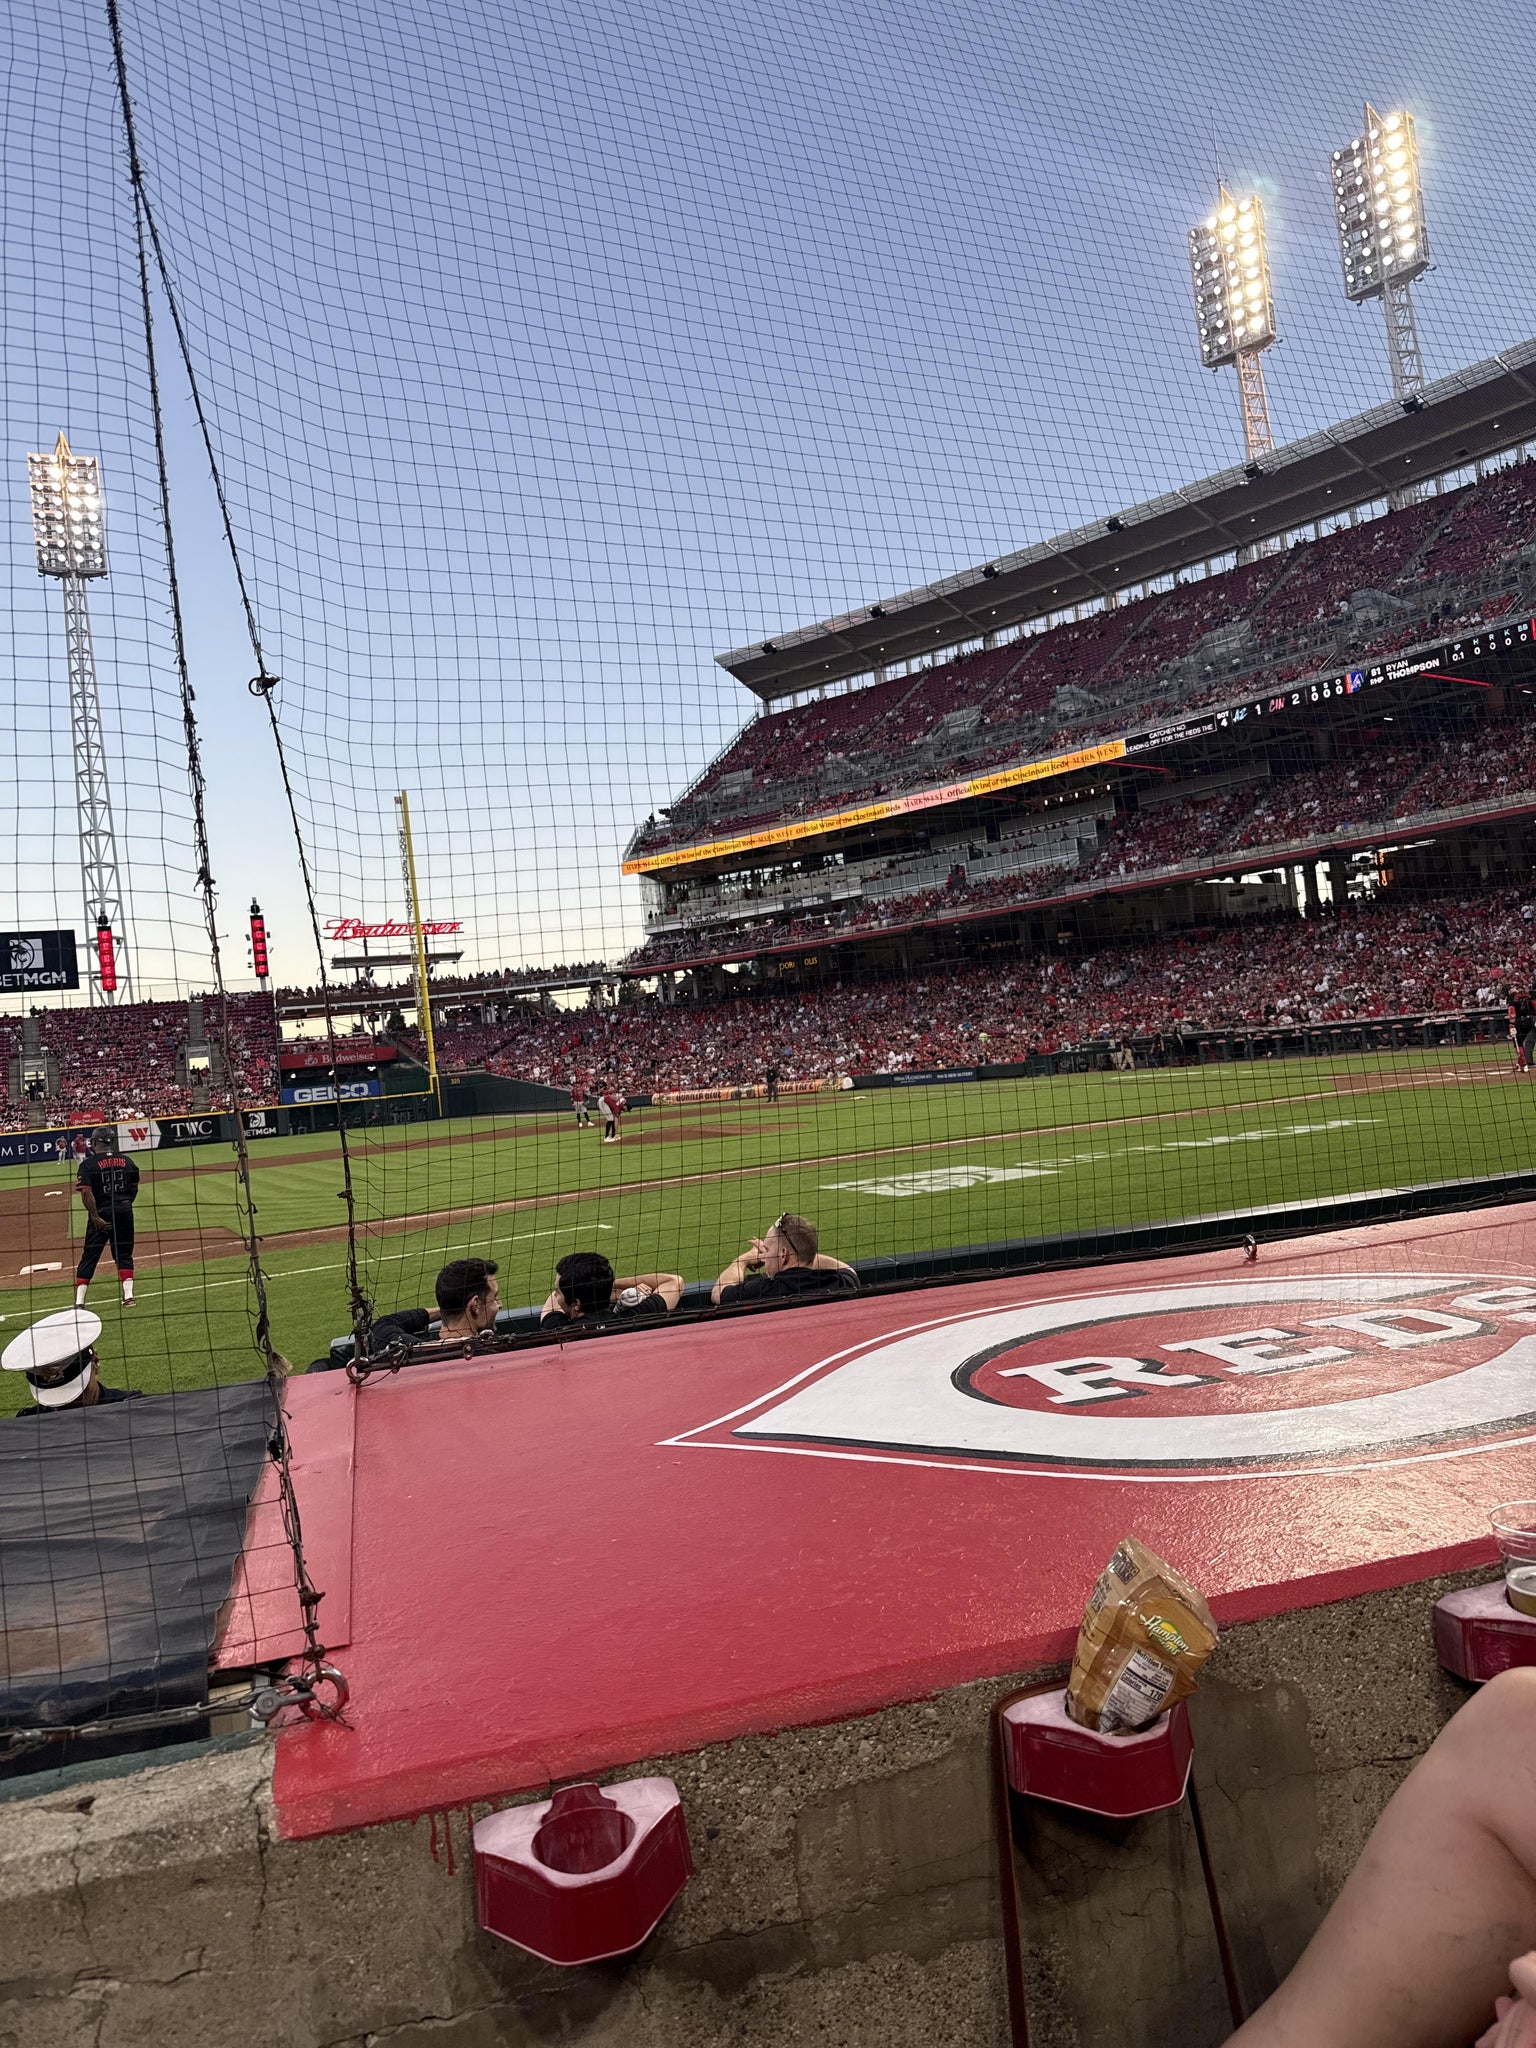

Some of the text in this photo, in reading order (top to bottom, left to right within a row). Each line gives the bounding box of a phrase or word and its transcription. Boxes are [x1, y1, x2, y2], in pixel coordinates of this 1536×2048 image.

[1517, 623, 1529, 632] BB
[1452, 633, 1527, 661] 0.1 0 0 0 0
[1386, 660, 1409, 672] RYAN
[1387, 658, 1440, 680] THOMPSON
[1311, 685, 1343, 701] 0 0 0
[1216, 711, 1230, 720] BOT
[1220, 693, 1300, 727] 4 AZ 1 CIN 2
[1127, 741, 1149, 753] LEADING
[1150, 738, 1161, 747] OFF
[1162, 735, 1173, 743] FOR
[1174, 732, 1185, 740] THE
[660, 855, 681, 865] Official
[703, 847, 712, 856] the
[795, 823, 819, 835] Official
[819, 819, 835, 830] Wine
[836, 817, 842, 827] of
[842, 814, 852, 824] the
[853, 808, 885, 821] Cincinnati
[947, 785, 972, 798] Official
[972, 780, 991, 792] Wine
[992, 777, 999, 787] of
[1000, 774, 1012, 785] the
[1013, 764, 1050, 781] Cincinnati
[1051, 761, 1069, 772] Reds
[1073, 754, 1096, 765] MARK
[1097, 746, 1119, 758] WEST
[0, 971, 67, 987] ETMGM
[293, 1083, 370, 1103] GEICO
[171, 1120, 213, 1138] TWC
[1, 1138, 91, 1157] MEDPE
[97, 1158, 126, 1169] HARRIS
[1143, 1615, 1189, 1653] Hampton
[1137, 1649, 1160, 1668] Nutrition
[1122, 1673, 1142, 1690] Calories
[1150, 1689, 1164, 1700] 170
